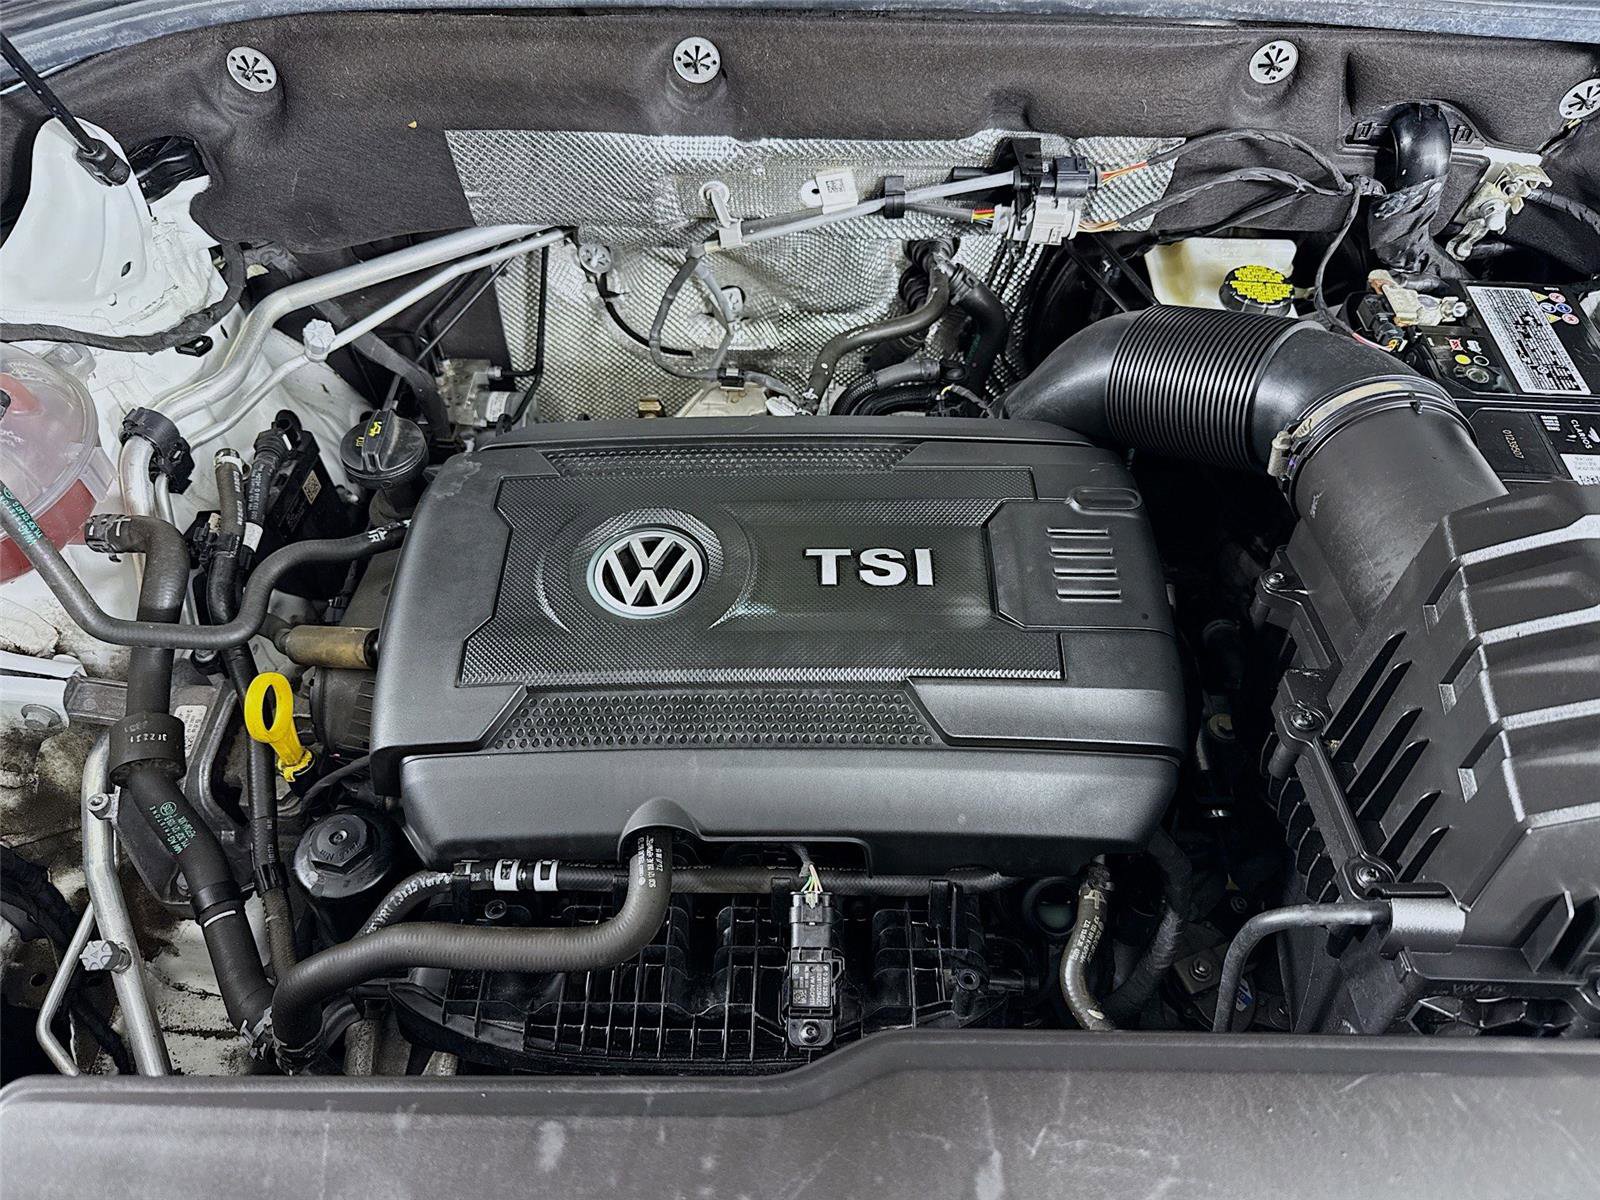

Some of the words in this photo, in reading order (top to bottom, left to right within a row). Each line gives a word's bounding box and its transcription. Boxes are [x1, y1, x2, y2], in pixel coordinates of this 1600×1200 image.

[1571, 420, 1592, 449] CLARIOS
[593, 530, 703, 614] VW
[805, 548, 934, 586] TSI
